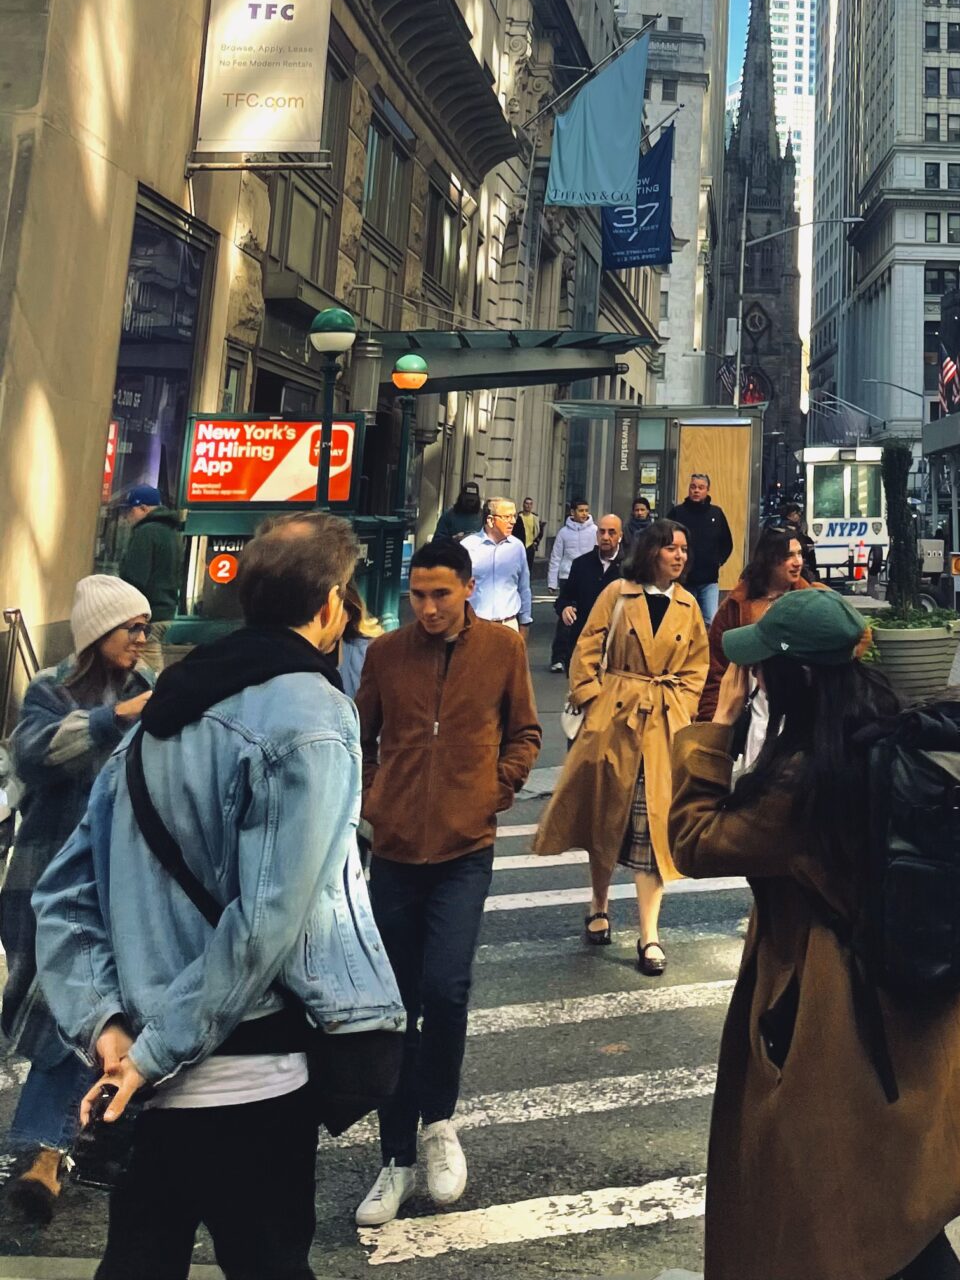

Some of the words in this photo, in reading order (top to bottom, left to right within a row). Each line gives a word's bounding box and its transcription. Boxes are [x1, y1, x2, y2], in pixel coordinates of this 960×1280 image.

[248, 3, 295, 21] TFC
[219, 59, 231, 67] No
[249, 60, 281, 68] Modern
[222, 92, 304, 110] TFC.com
[552, 189, 599, 201] TIFFANY
[600, 190, 609, 200] &
[612, 202, 660, 242] 37
[197, 423, 241, 440] New
[243, 423, 297, 440] York's
[195, 441, 216, 458] #1
[217, 441, 275, 462] Hiring
[620, 418, 631, 471] Newsstand
[192, 457, 233, 477] App
[825, 521, 868, 537] NYPD
[213, 539, 244, 552] Wall
[216, 559, 230, 578] 2
